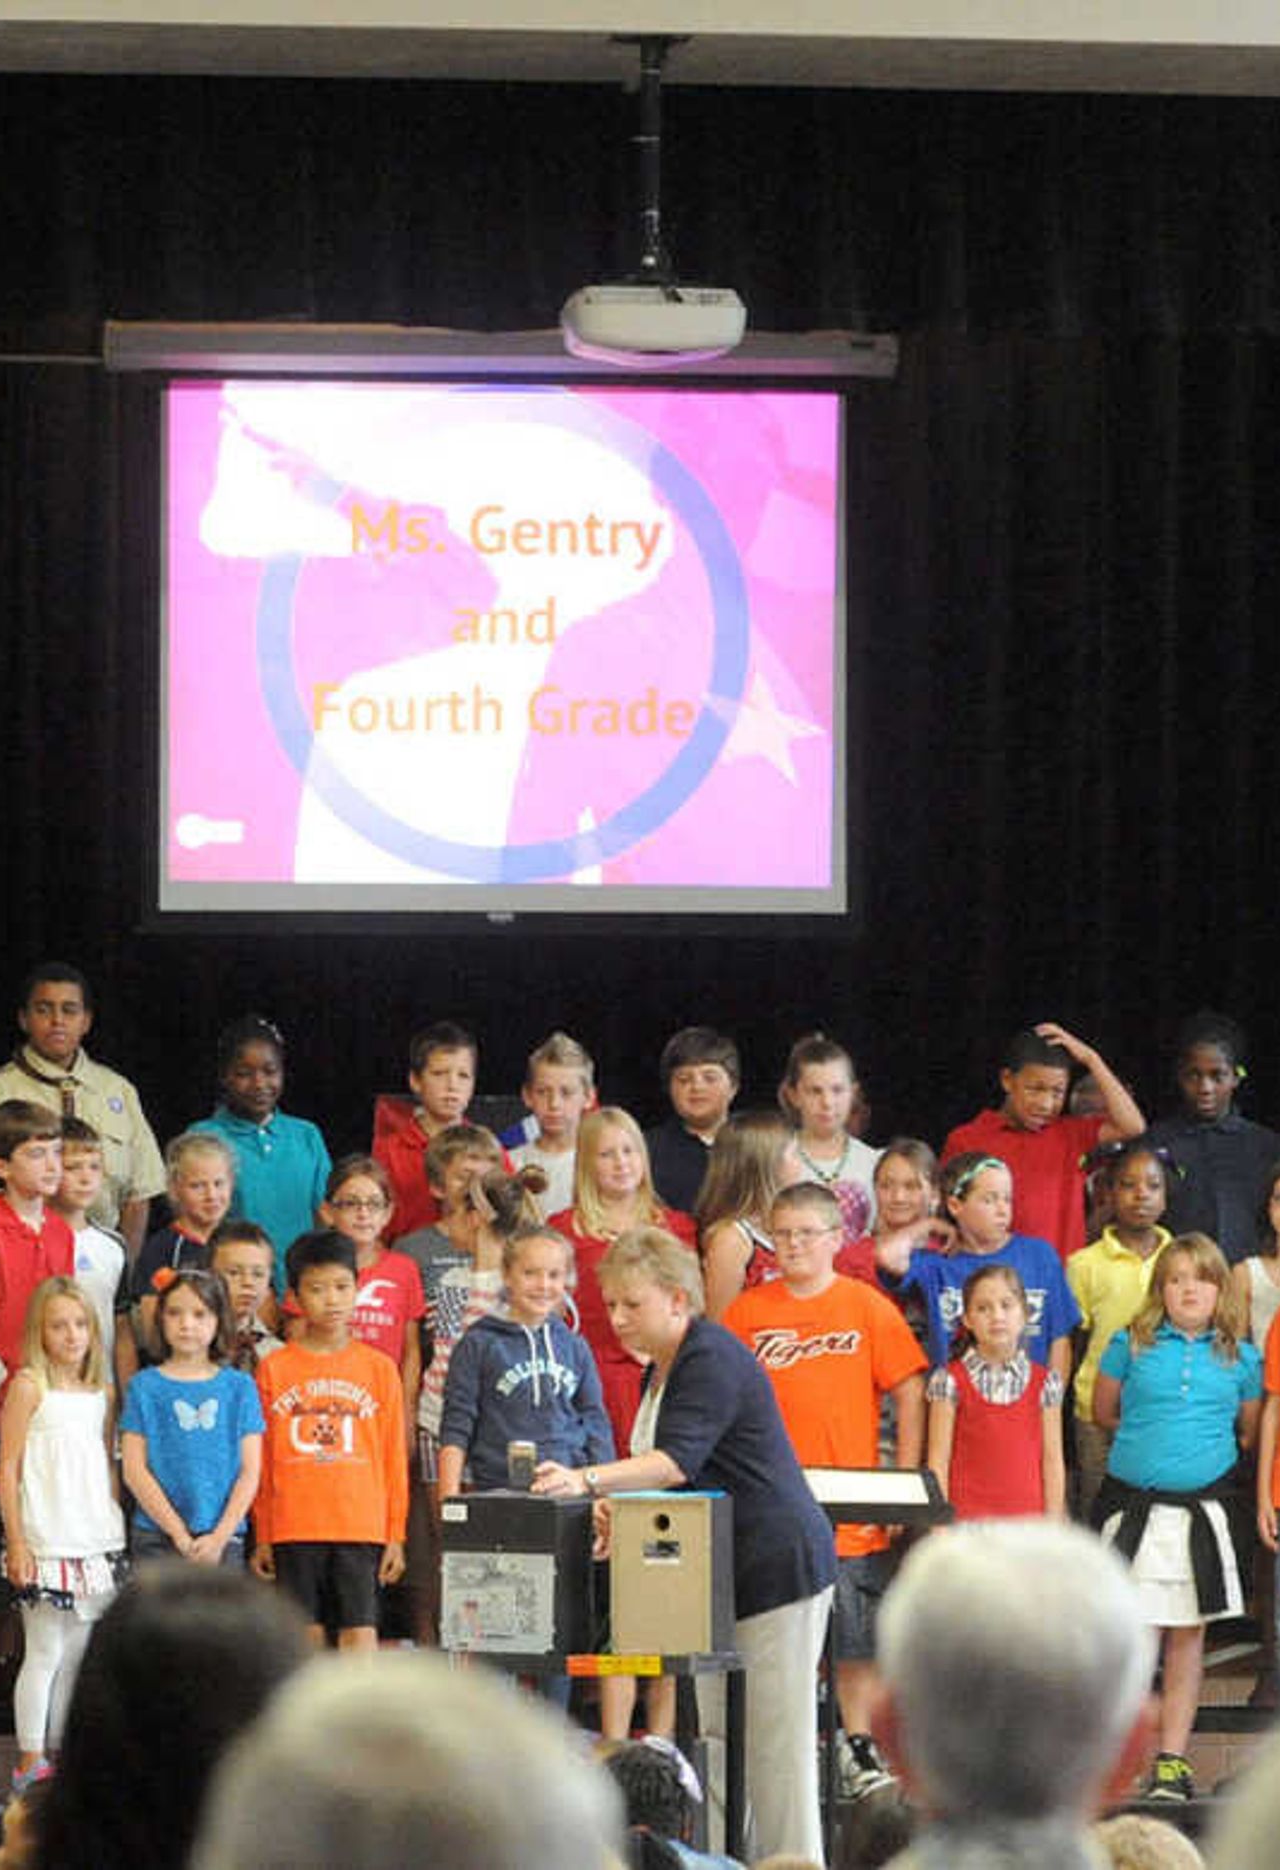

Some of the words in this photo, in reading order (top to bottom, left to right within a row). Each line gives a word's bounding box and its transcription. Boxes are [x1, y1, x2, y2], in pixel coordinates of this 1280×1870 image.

[350, 502, 447, 555] Ms.
[469, 504, 664, 571] Gentry
[451, 597, 557, 645] and
[312, 682, 504, 733] Fourth
[528, 684, 695, 739] Grade
[753, 1329, 860, 1370] Tigers
